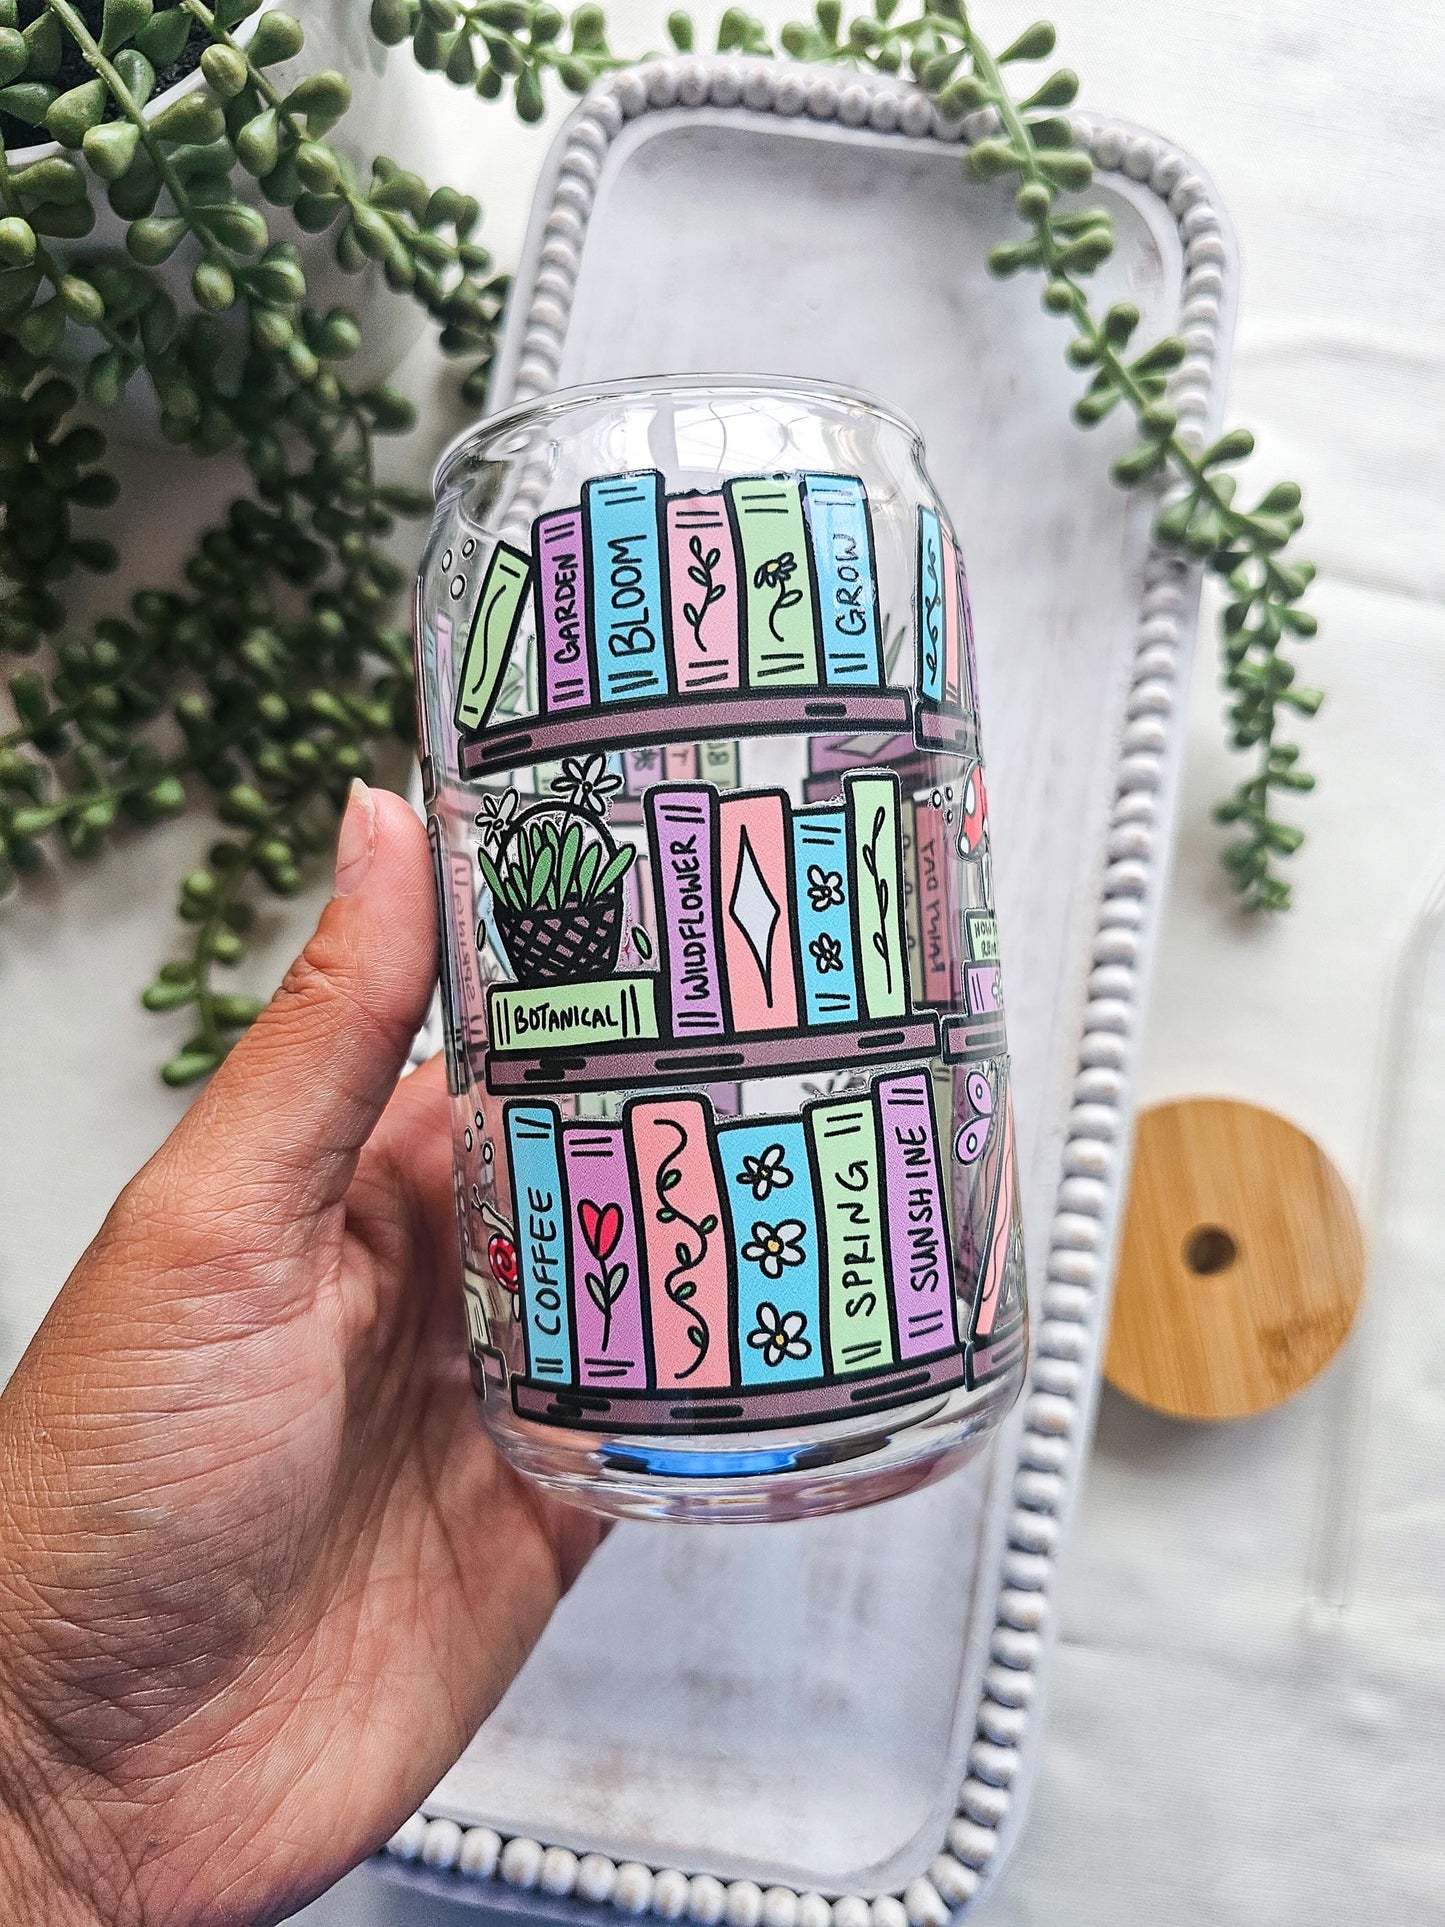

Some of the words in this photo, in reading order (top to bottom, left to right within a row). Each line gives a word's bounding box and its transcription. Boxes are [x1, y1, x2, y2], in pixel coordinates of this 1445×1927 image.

[553, 553, 580, 665] GARDEN
[608, 534, 656, 658] BLOOM
[834, 532, 869, 635] GROW
[670, 835, 709, 1002] WILDFLOWER
[513, 1002, 619, 1034] BOTANICAL
[529, 1188, 561, 1336] COFFEE
[835, 1158, 875, 1317] SPRING
[896, 1124, 938, 1293] SUNSHINE
